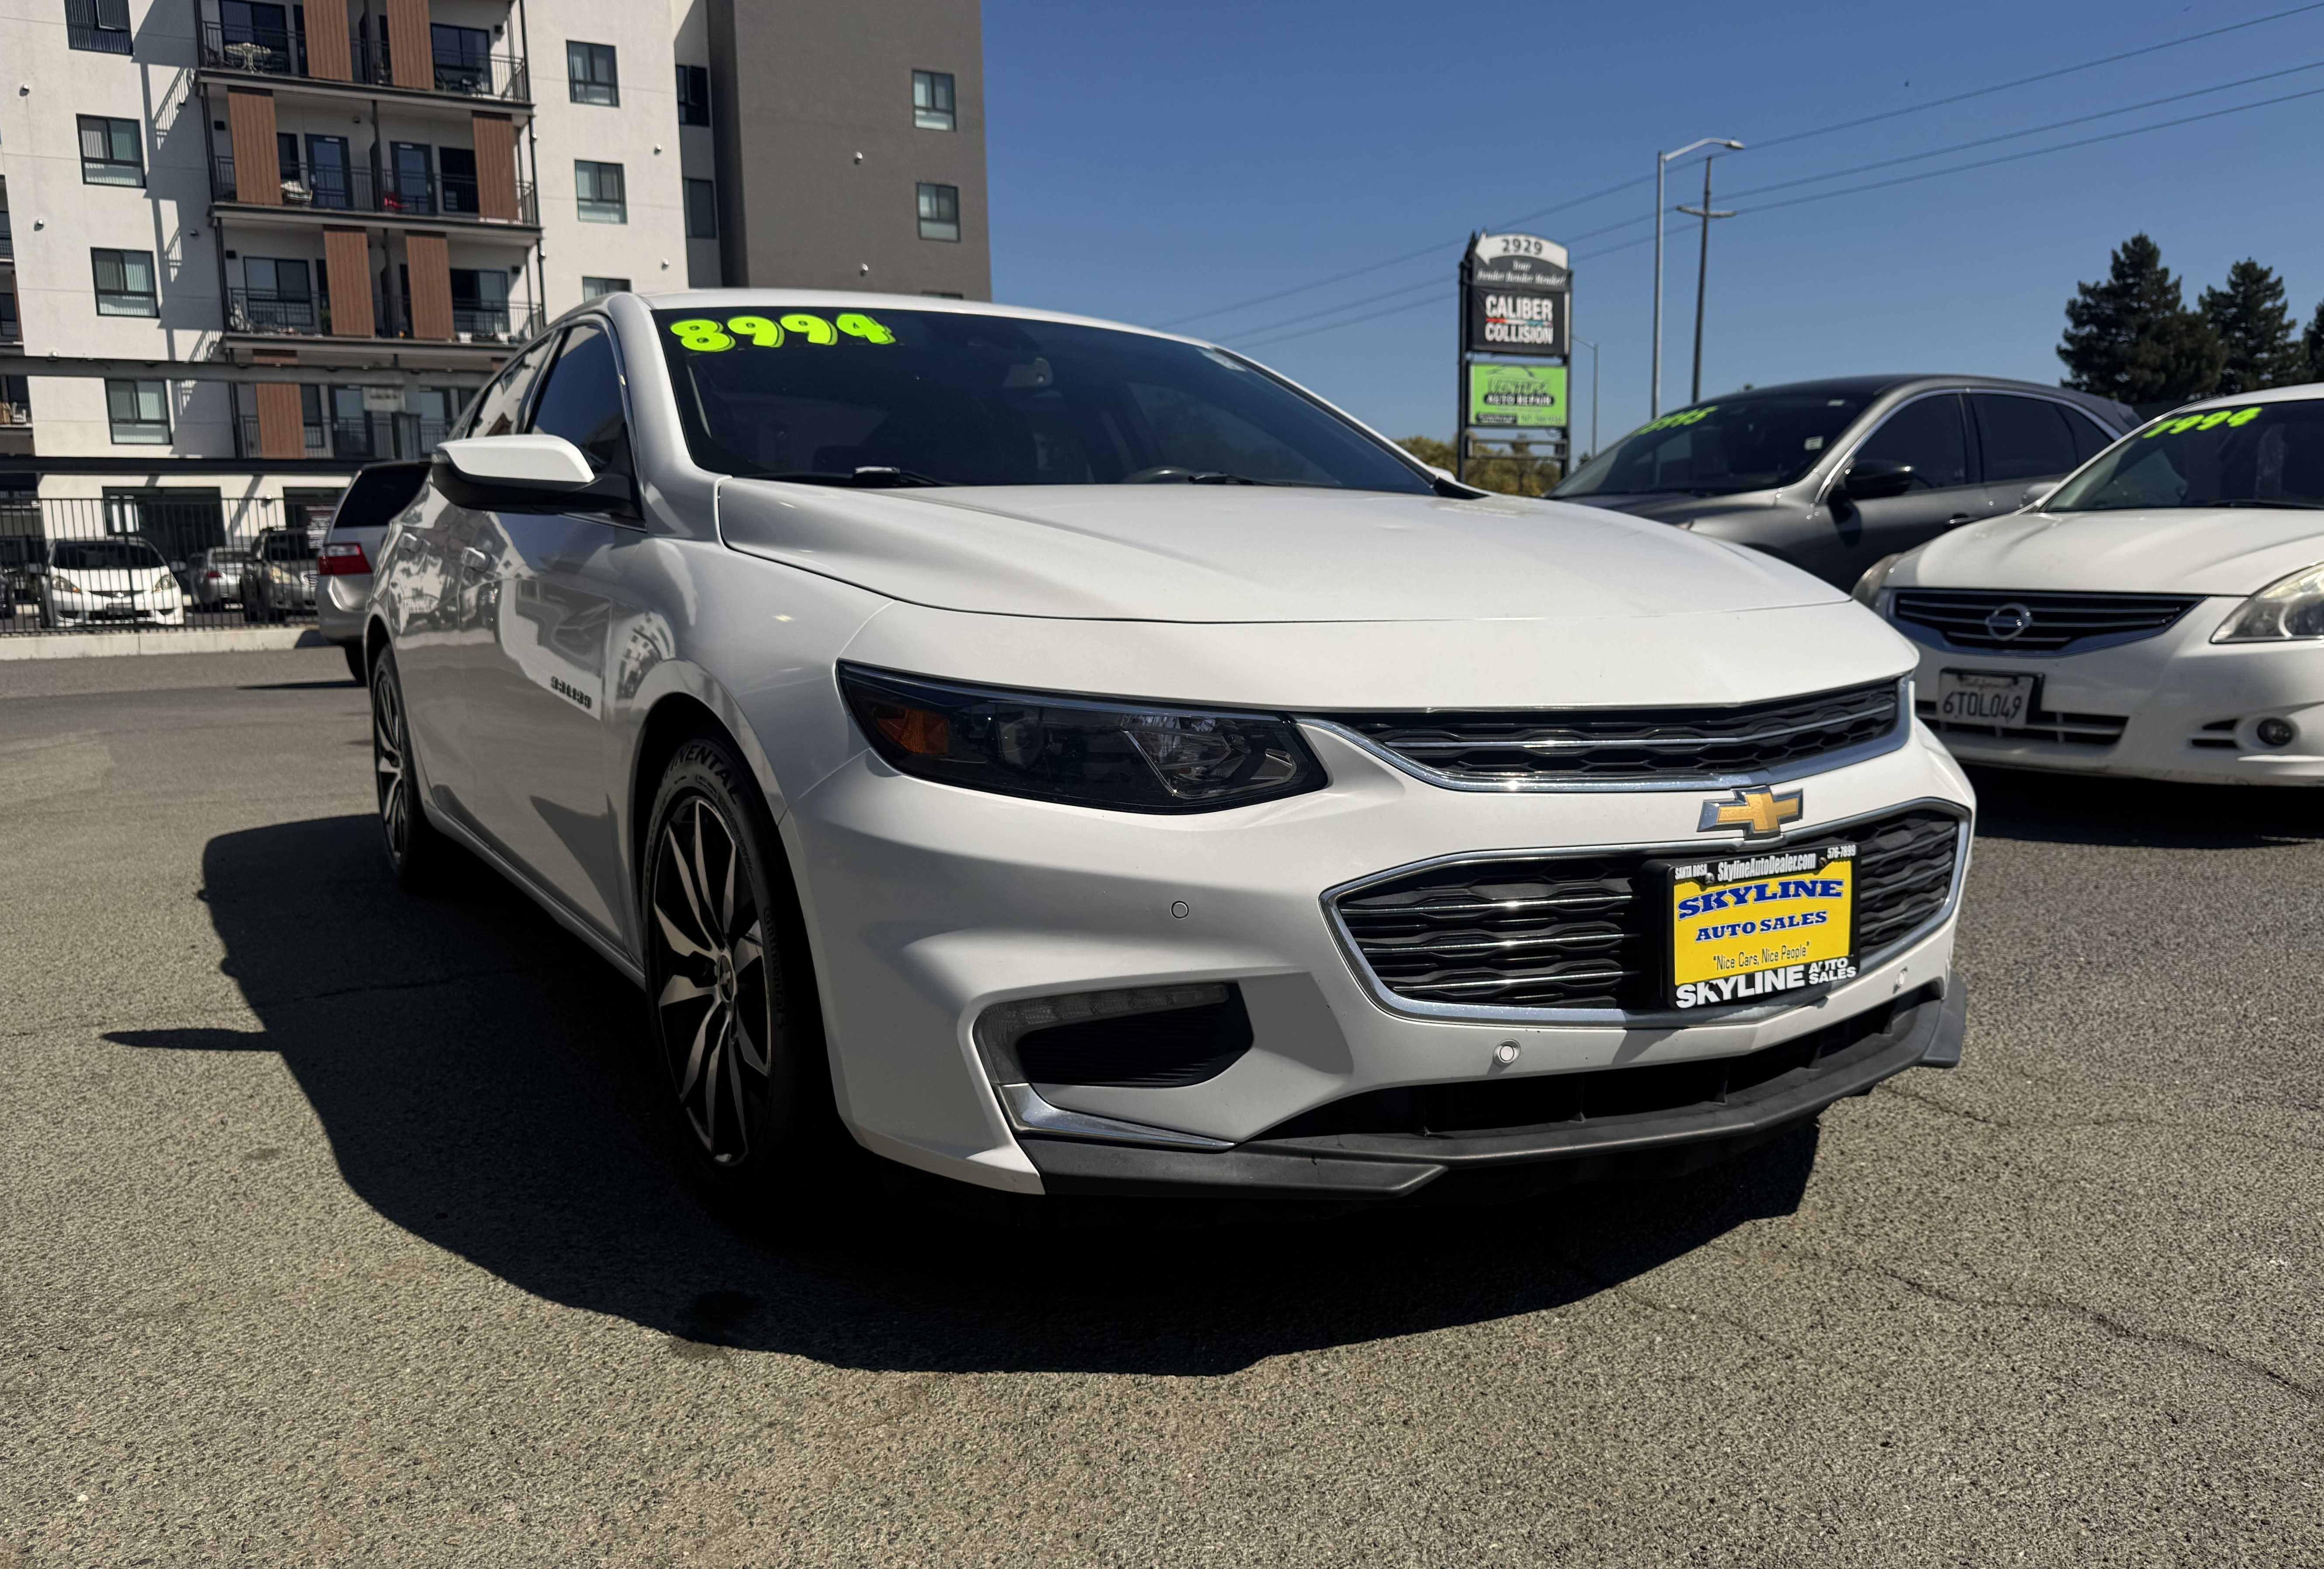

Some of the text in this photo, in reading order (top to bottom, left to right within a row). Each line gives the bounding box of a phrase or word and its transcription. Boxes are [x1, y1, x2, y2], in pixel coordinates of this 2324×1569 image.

[1502, 238, 1542, 255] 2929
[1485, 294, 1553, 320] CALIBER
[670, 312, 897, 352] 8994
[1485, 323, 1554, 345] COLLISION
[2141, 407, 2263, 439] 7994
[1675, 845, 1857, 882] SANTA ROSA SkylineAutoDealer.com 576-7899
[1677, 879, 1844, 921] SKYLINE
[1695, 910, 1828, 943] AUTO SALES
[1713, 941, 1810, 971] "Nice Cars, Nice People"
[1809, 957, 1848, 974] AUTO
[1675, 965, 1805, 1008] SKYLINE
[1809, 966, 1858, 985] SALES
